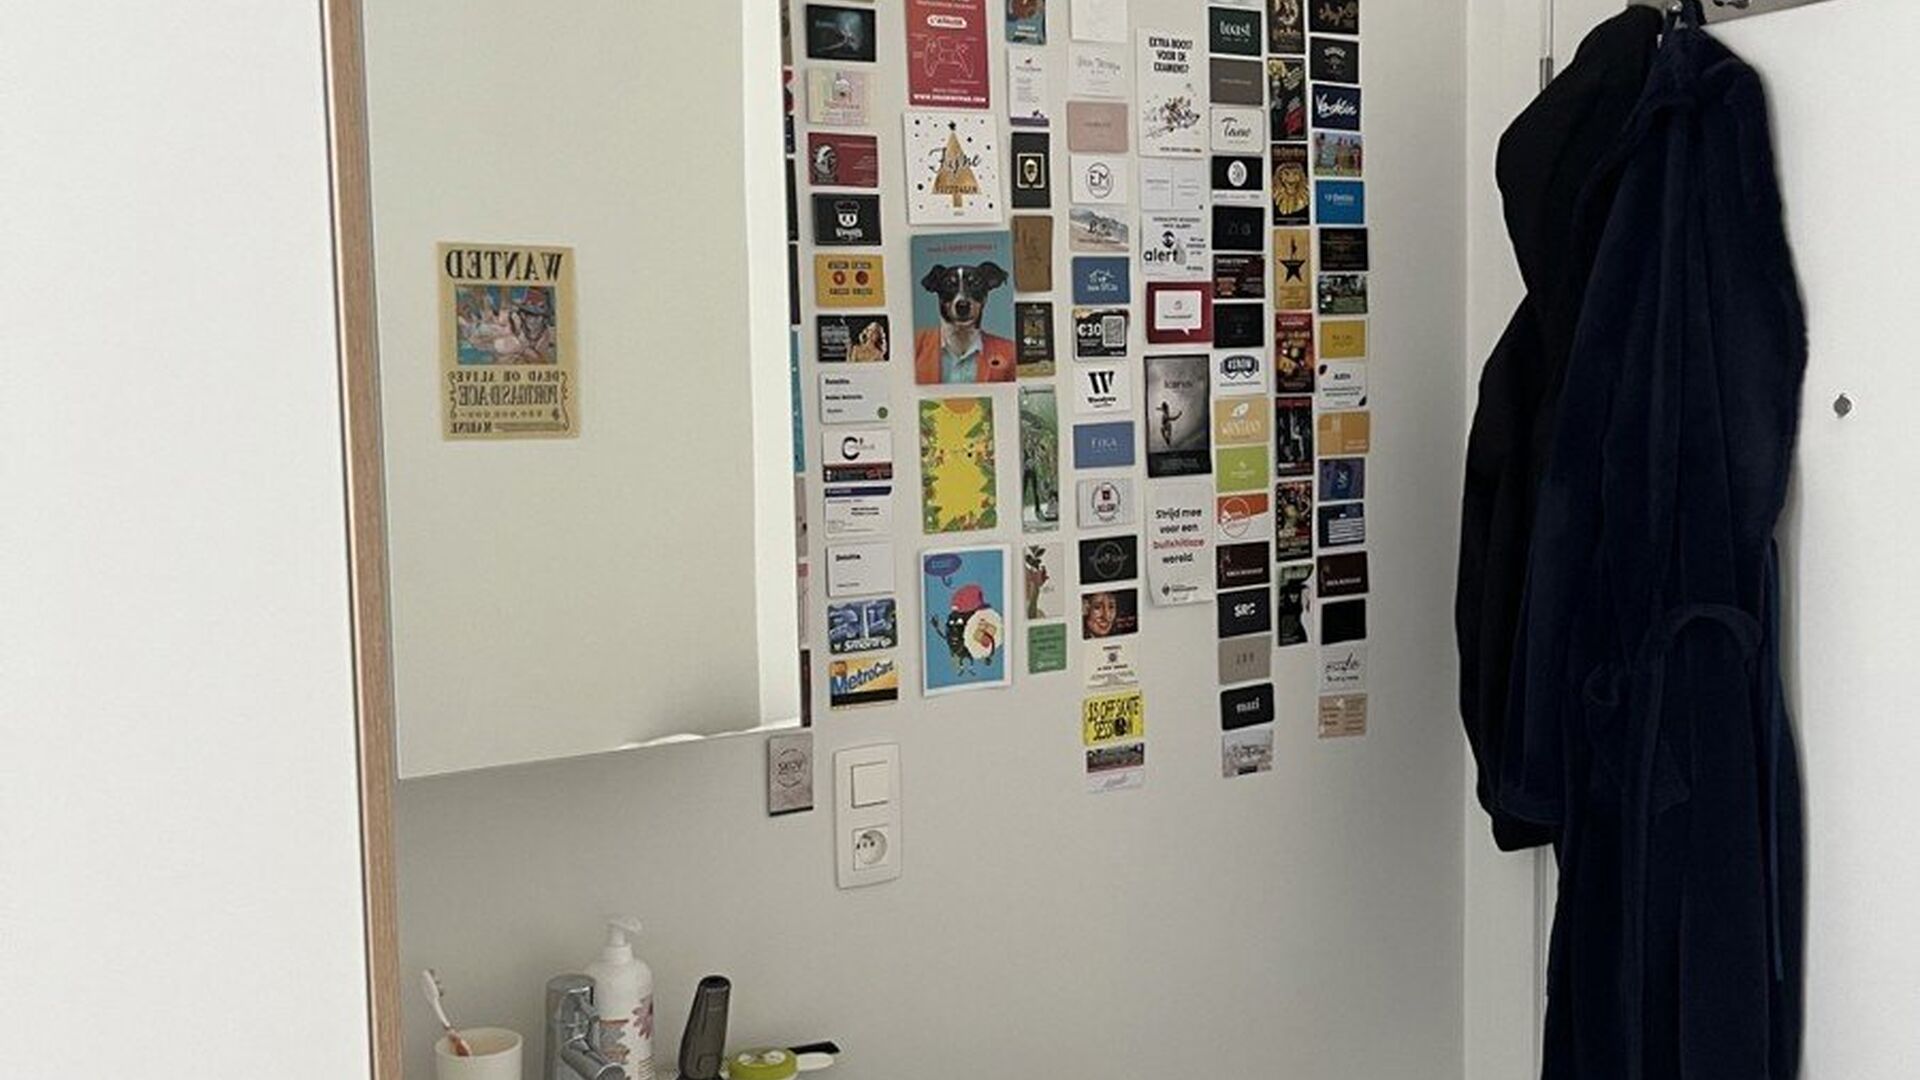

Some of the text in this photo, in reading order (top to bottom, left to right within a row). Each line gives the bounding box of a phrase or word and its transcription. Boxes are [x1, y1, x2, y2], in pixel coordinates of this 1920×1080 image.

[1143, 247, 1177, 262] alert
[1156, 508, 1202, 520] Strijd mee
[1160, 523, 1199, 534] voor een
